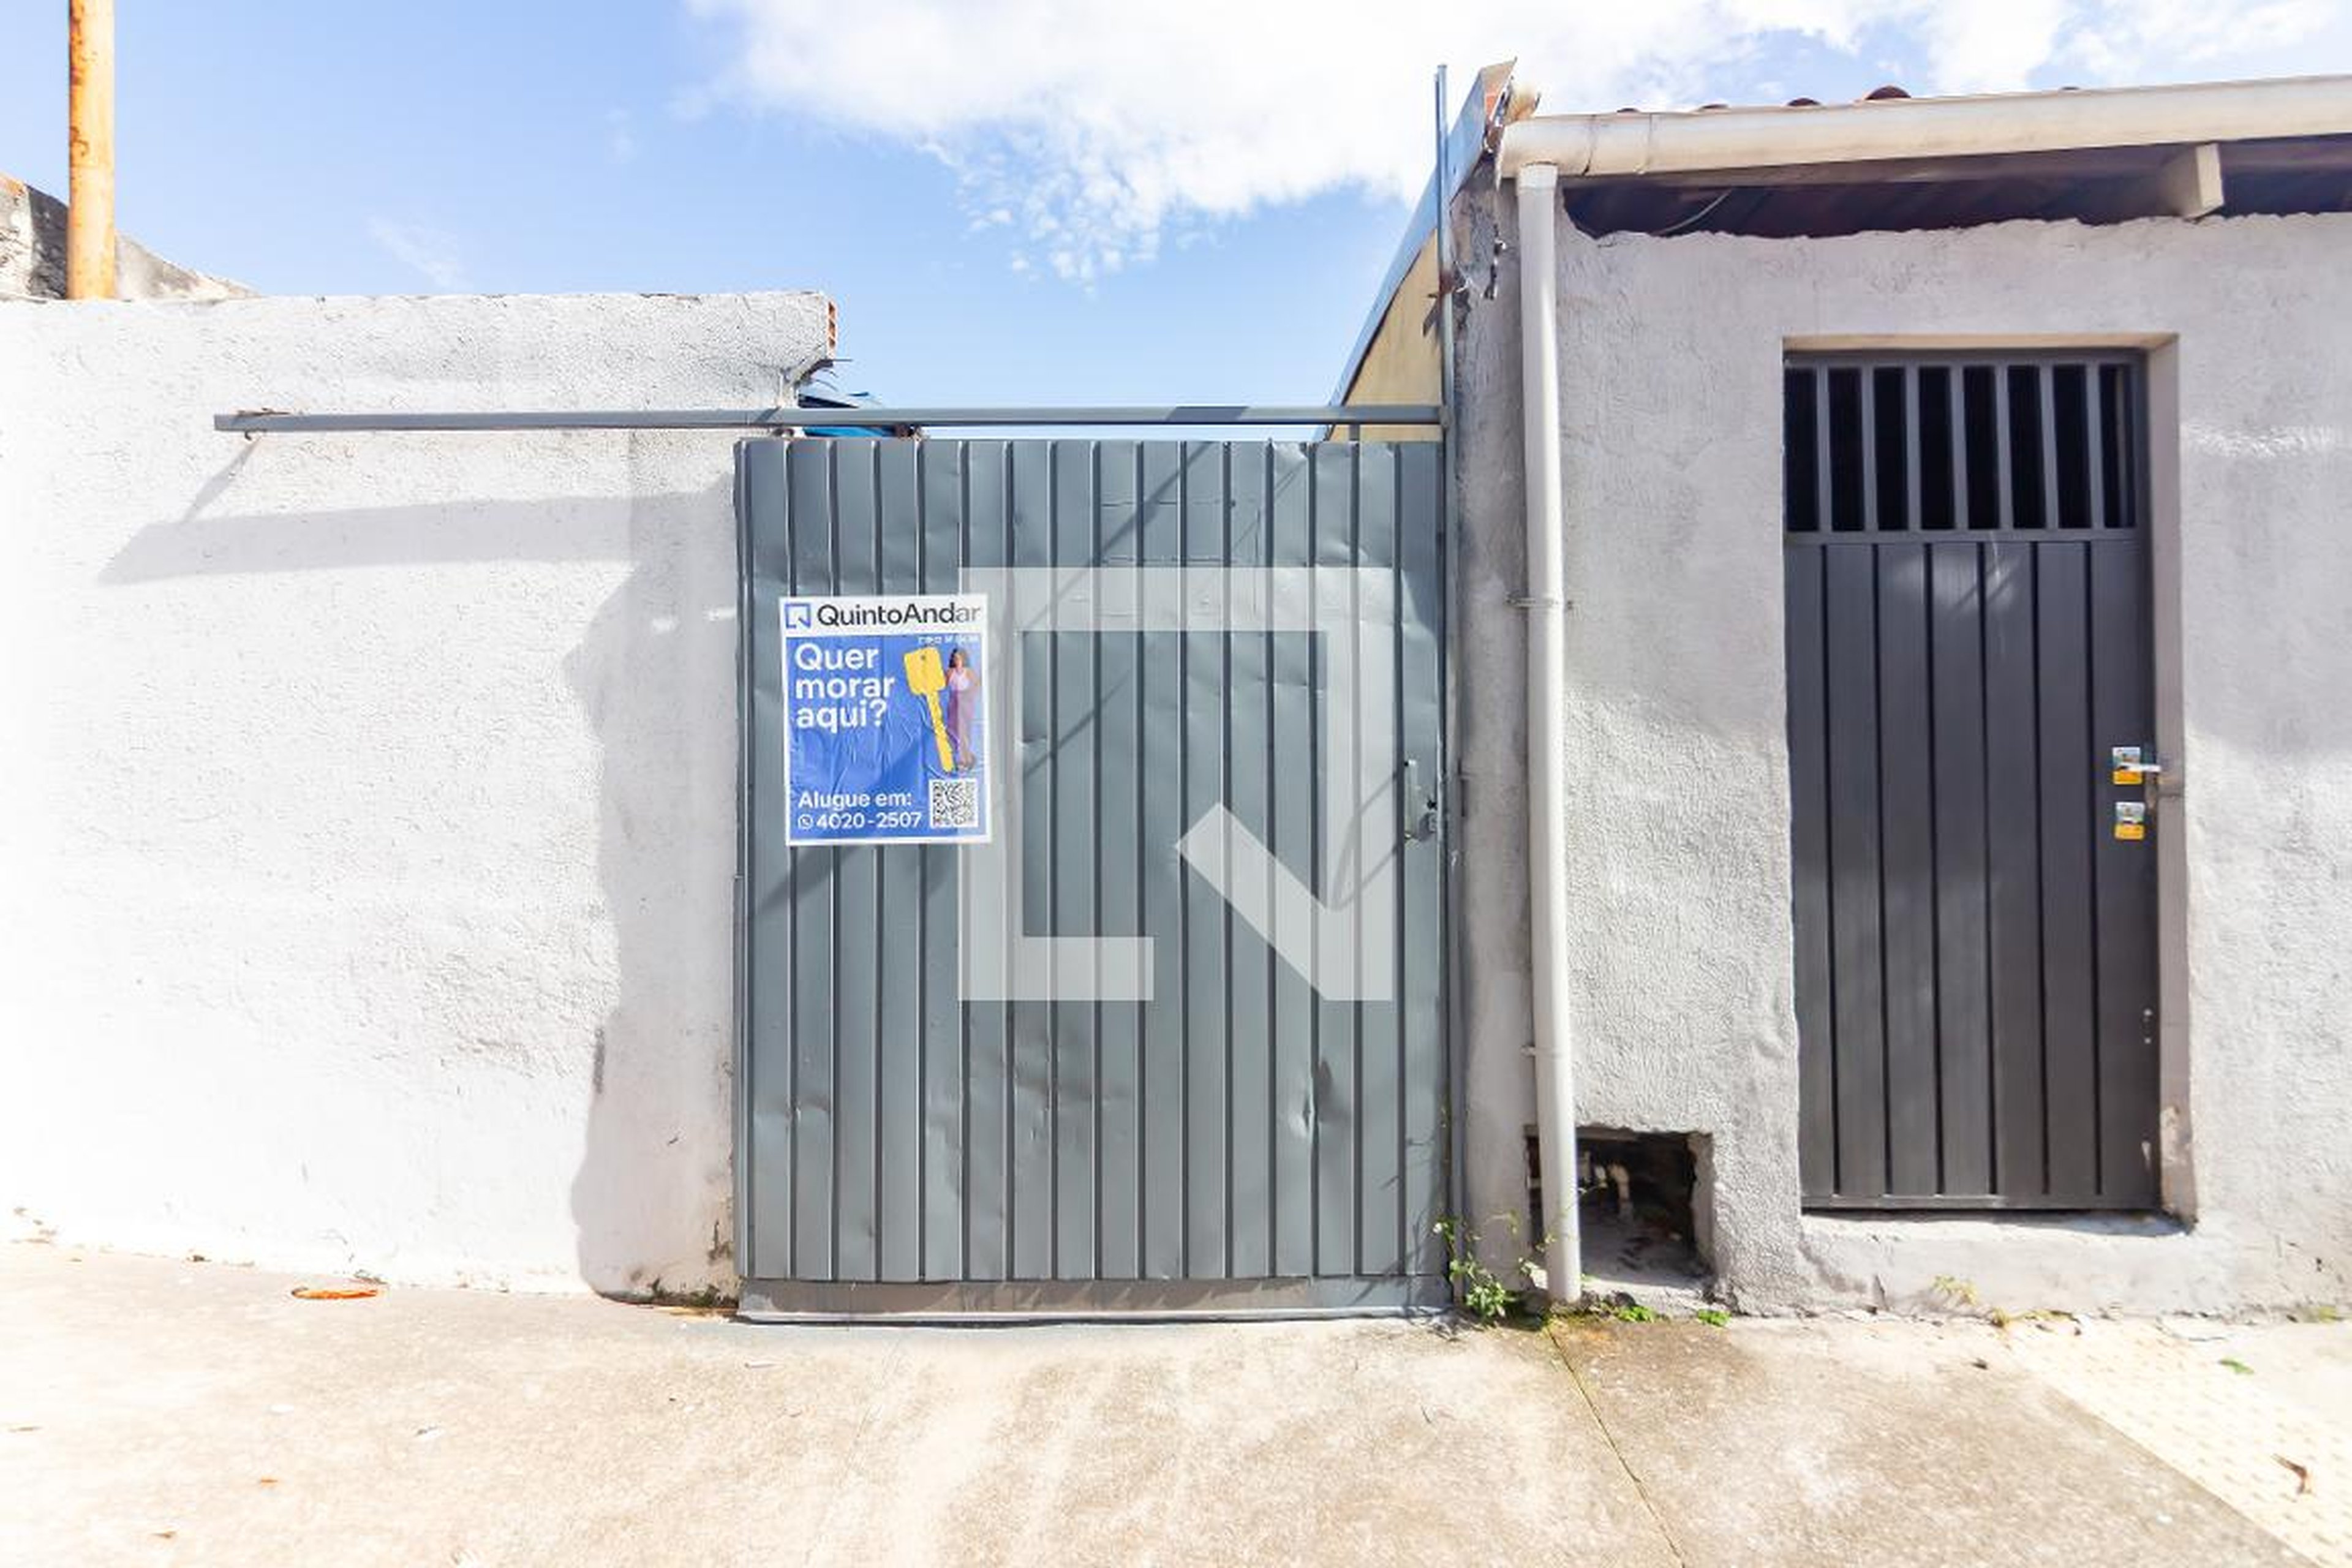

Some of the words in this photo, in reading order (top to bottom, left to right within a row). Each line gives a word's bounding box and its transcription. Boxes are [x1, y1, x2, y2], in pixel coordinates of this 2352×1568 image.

[818, 603, 981, 626] QuintoAndar
[796, 643, 878, 669] Quer
[796, 676, 895, 699] morar
[797, 700, 887, 734] aqui?
[798, 792, 870, 810] Alugue
[875, 793, 912, 807] em:
